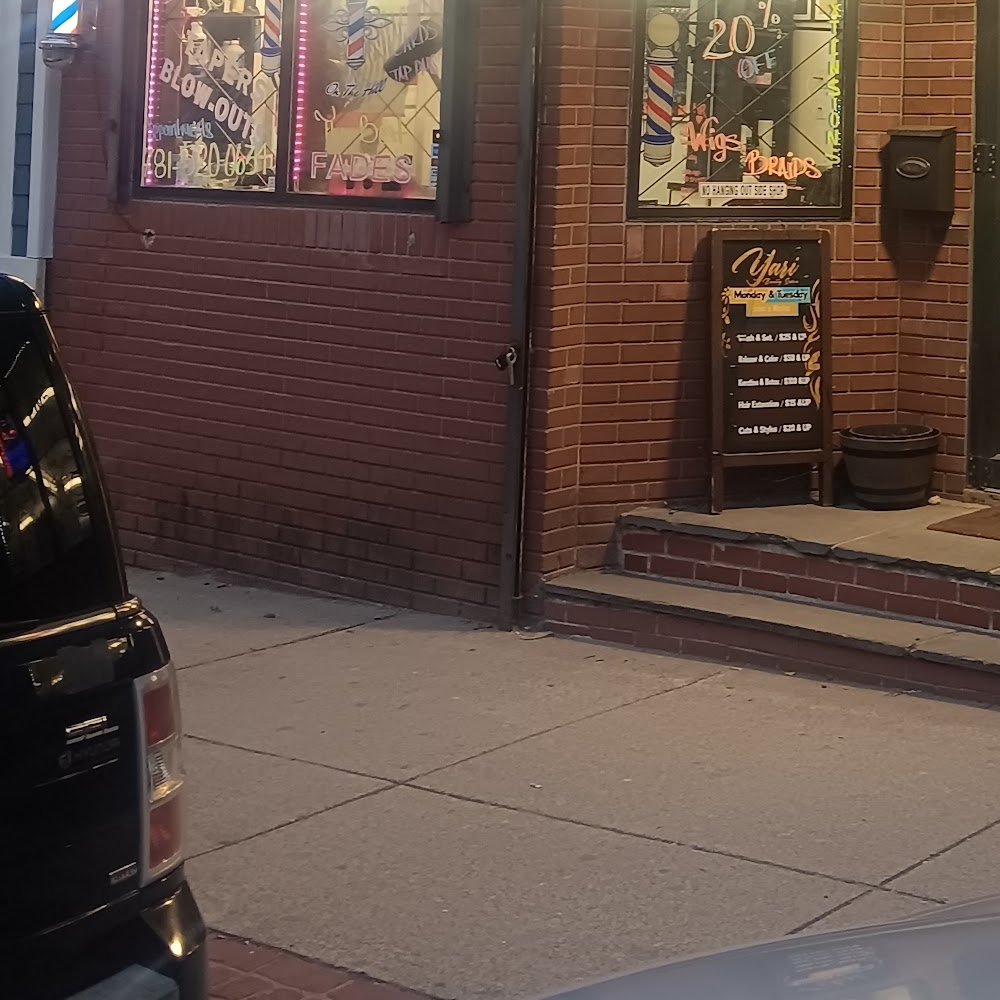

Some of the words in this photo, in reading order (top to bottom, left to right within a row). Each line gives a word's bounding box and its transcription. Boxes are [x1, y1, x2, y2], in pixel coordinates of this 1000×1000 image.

[685, 116, 747, 162] Wigs
[311, 152, 413, 185] FADES
[701, 185, 711, 196] NO
[712, 185, 738, 196] HANGING
[740, 185, 752, 196] OUT
[754, 185, 767, 197] SIDE
[769, 185, 785, 197] SHOP
[732, 247, 800, 287] Yari
[734, 290, 766, 301] Monday
[768, 290, 775, 299] &
[777, 289, 808, 301] Tuesday
